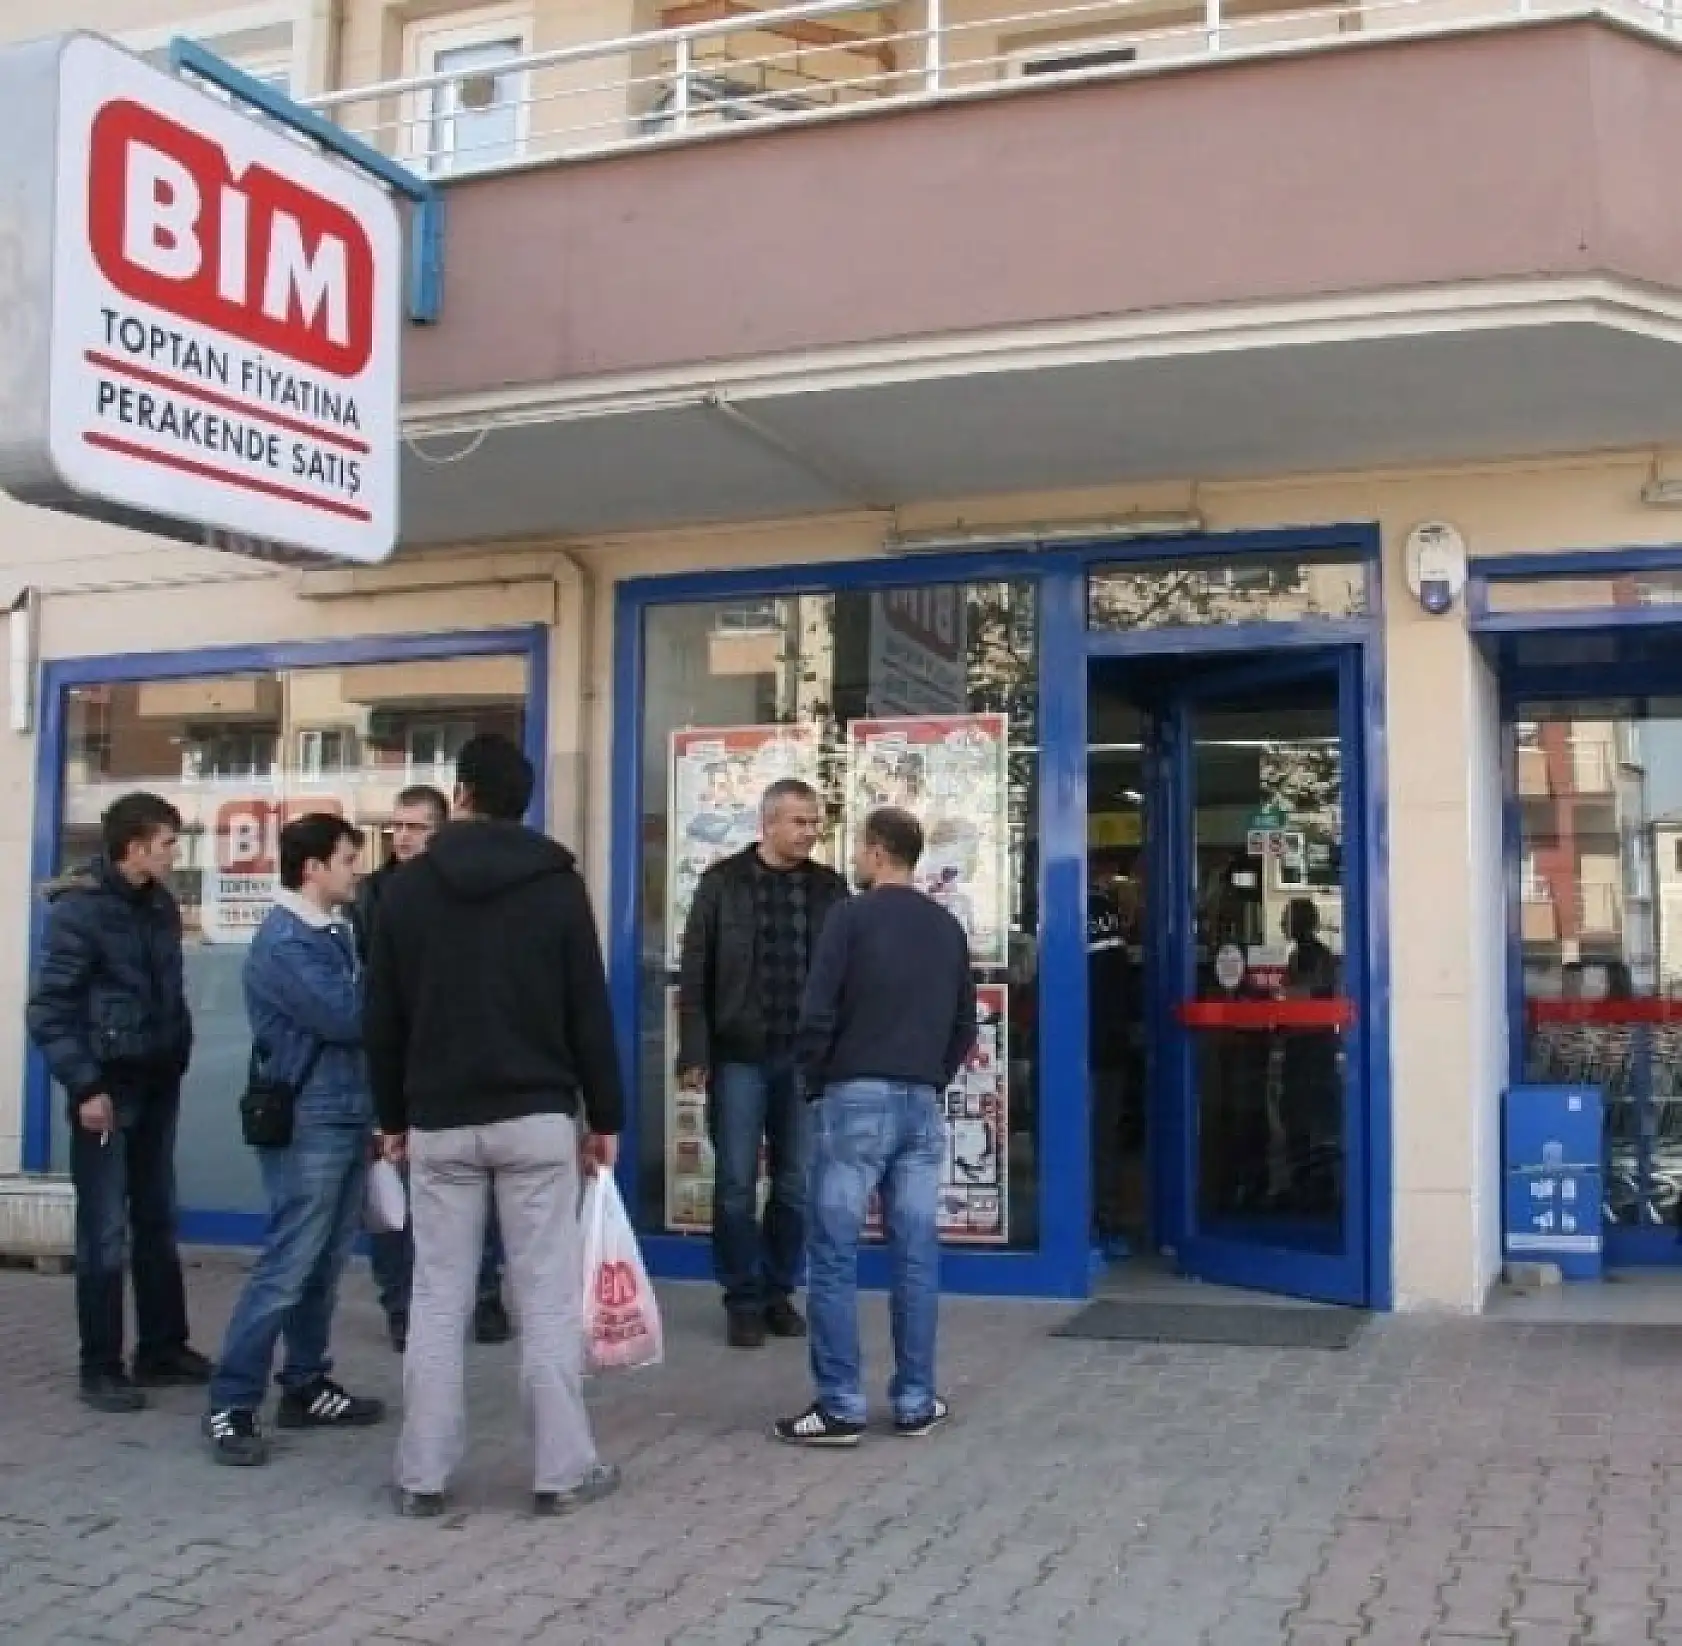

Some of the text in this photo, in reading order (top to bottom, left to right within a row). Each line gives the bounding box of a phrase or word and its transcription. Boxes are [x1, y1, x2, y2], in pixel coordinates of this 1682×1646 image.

[100, 308, 361, 431] TOPTAN FİYATINA
[97, 379, 361, 499] PERAKENDE SATIŞ
